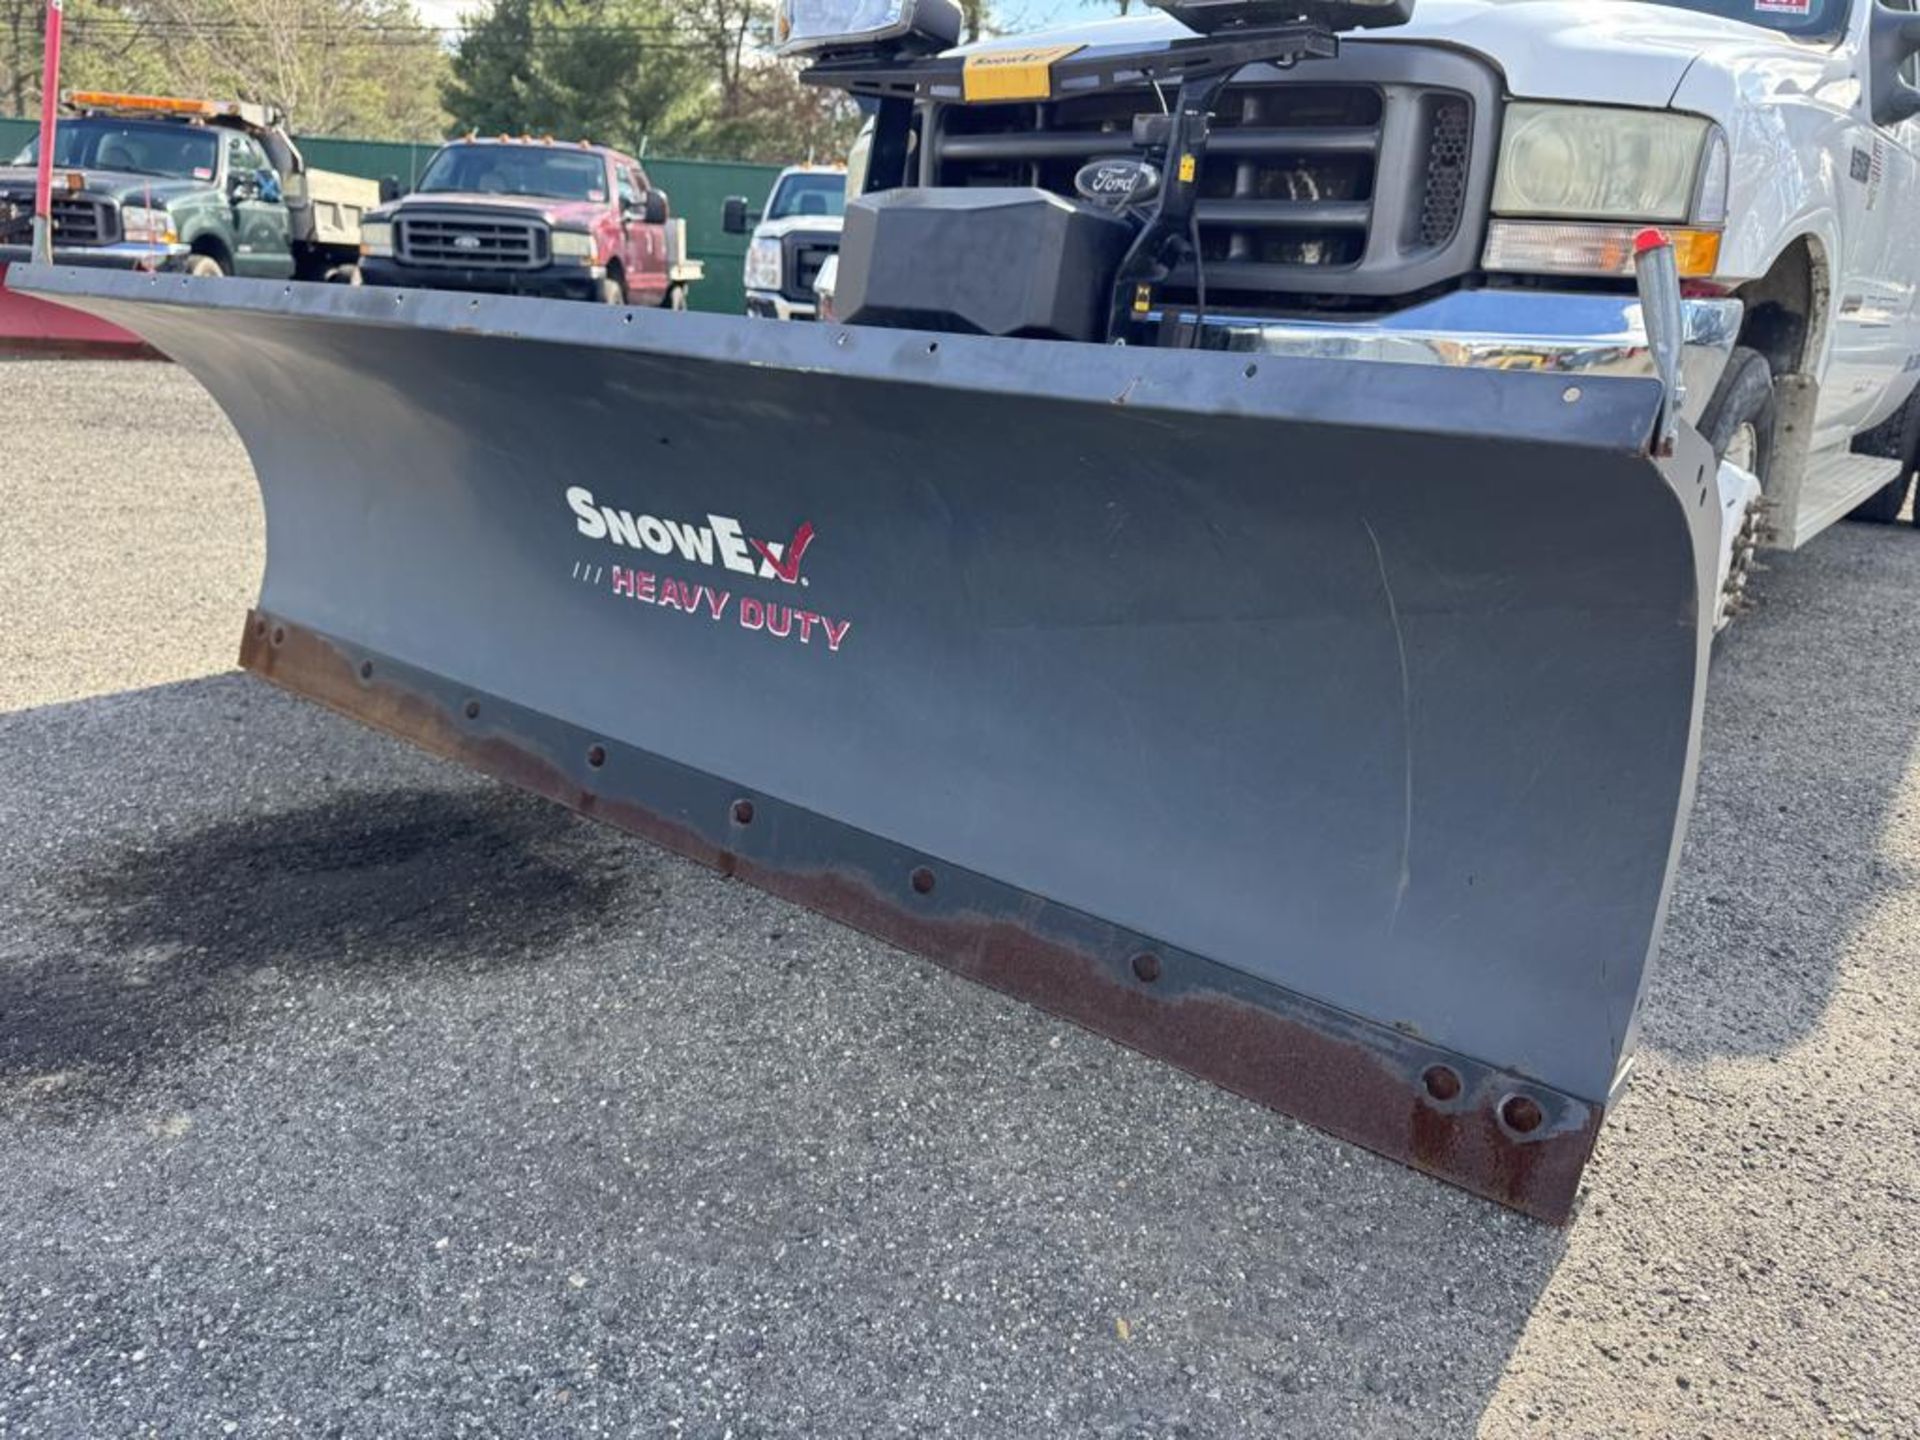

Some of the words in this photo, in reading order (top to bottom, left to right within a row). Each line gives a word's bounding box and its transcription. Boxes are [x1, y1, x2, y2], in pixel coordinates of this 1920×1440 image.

[1092, 168, 1138, 192] Ford
[612, 565, 730, 620] HEAVY
[740, 596, 851, 651] DUTY
